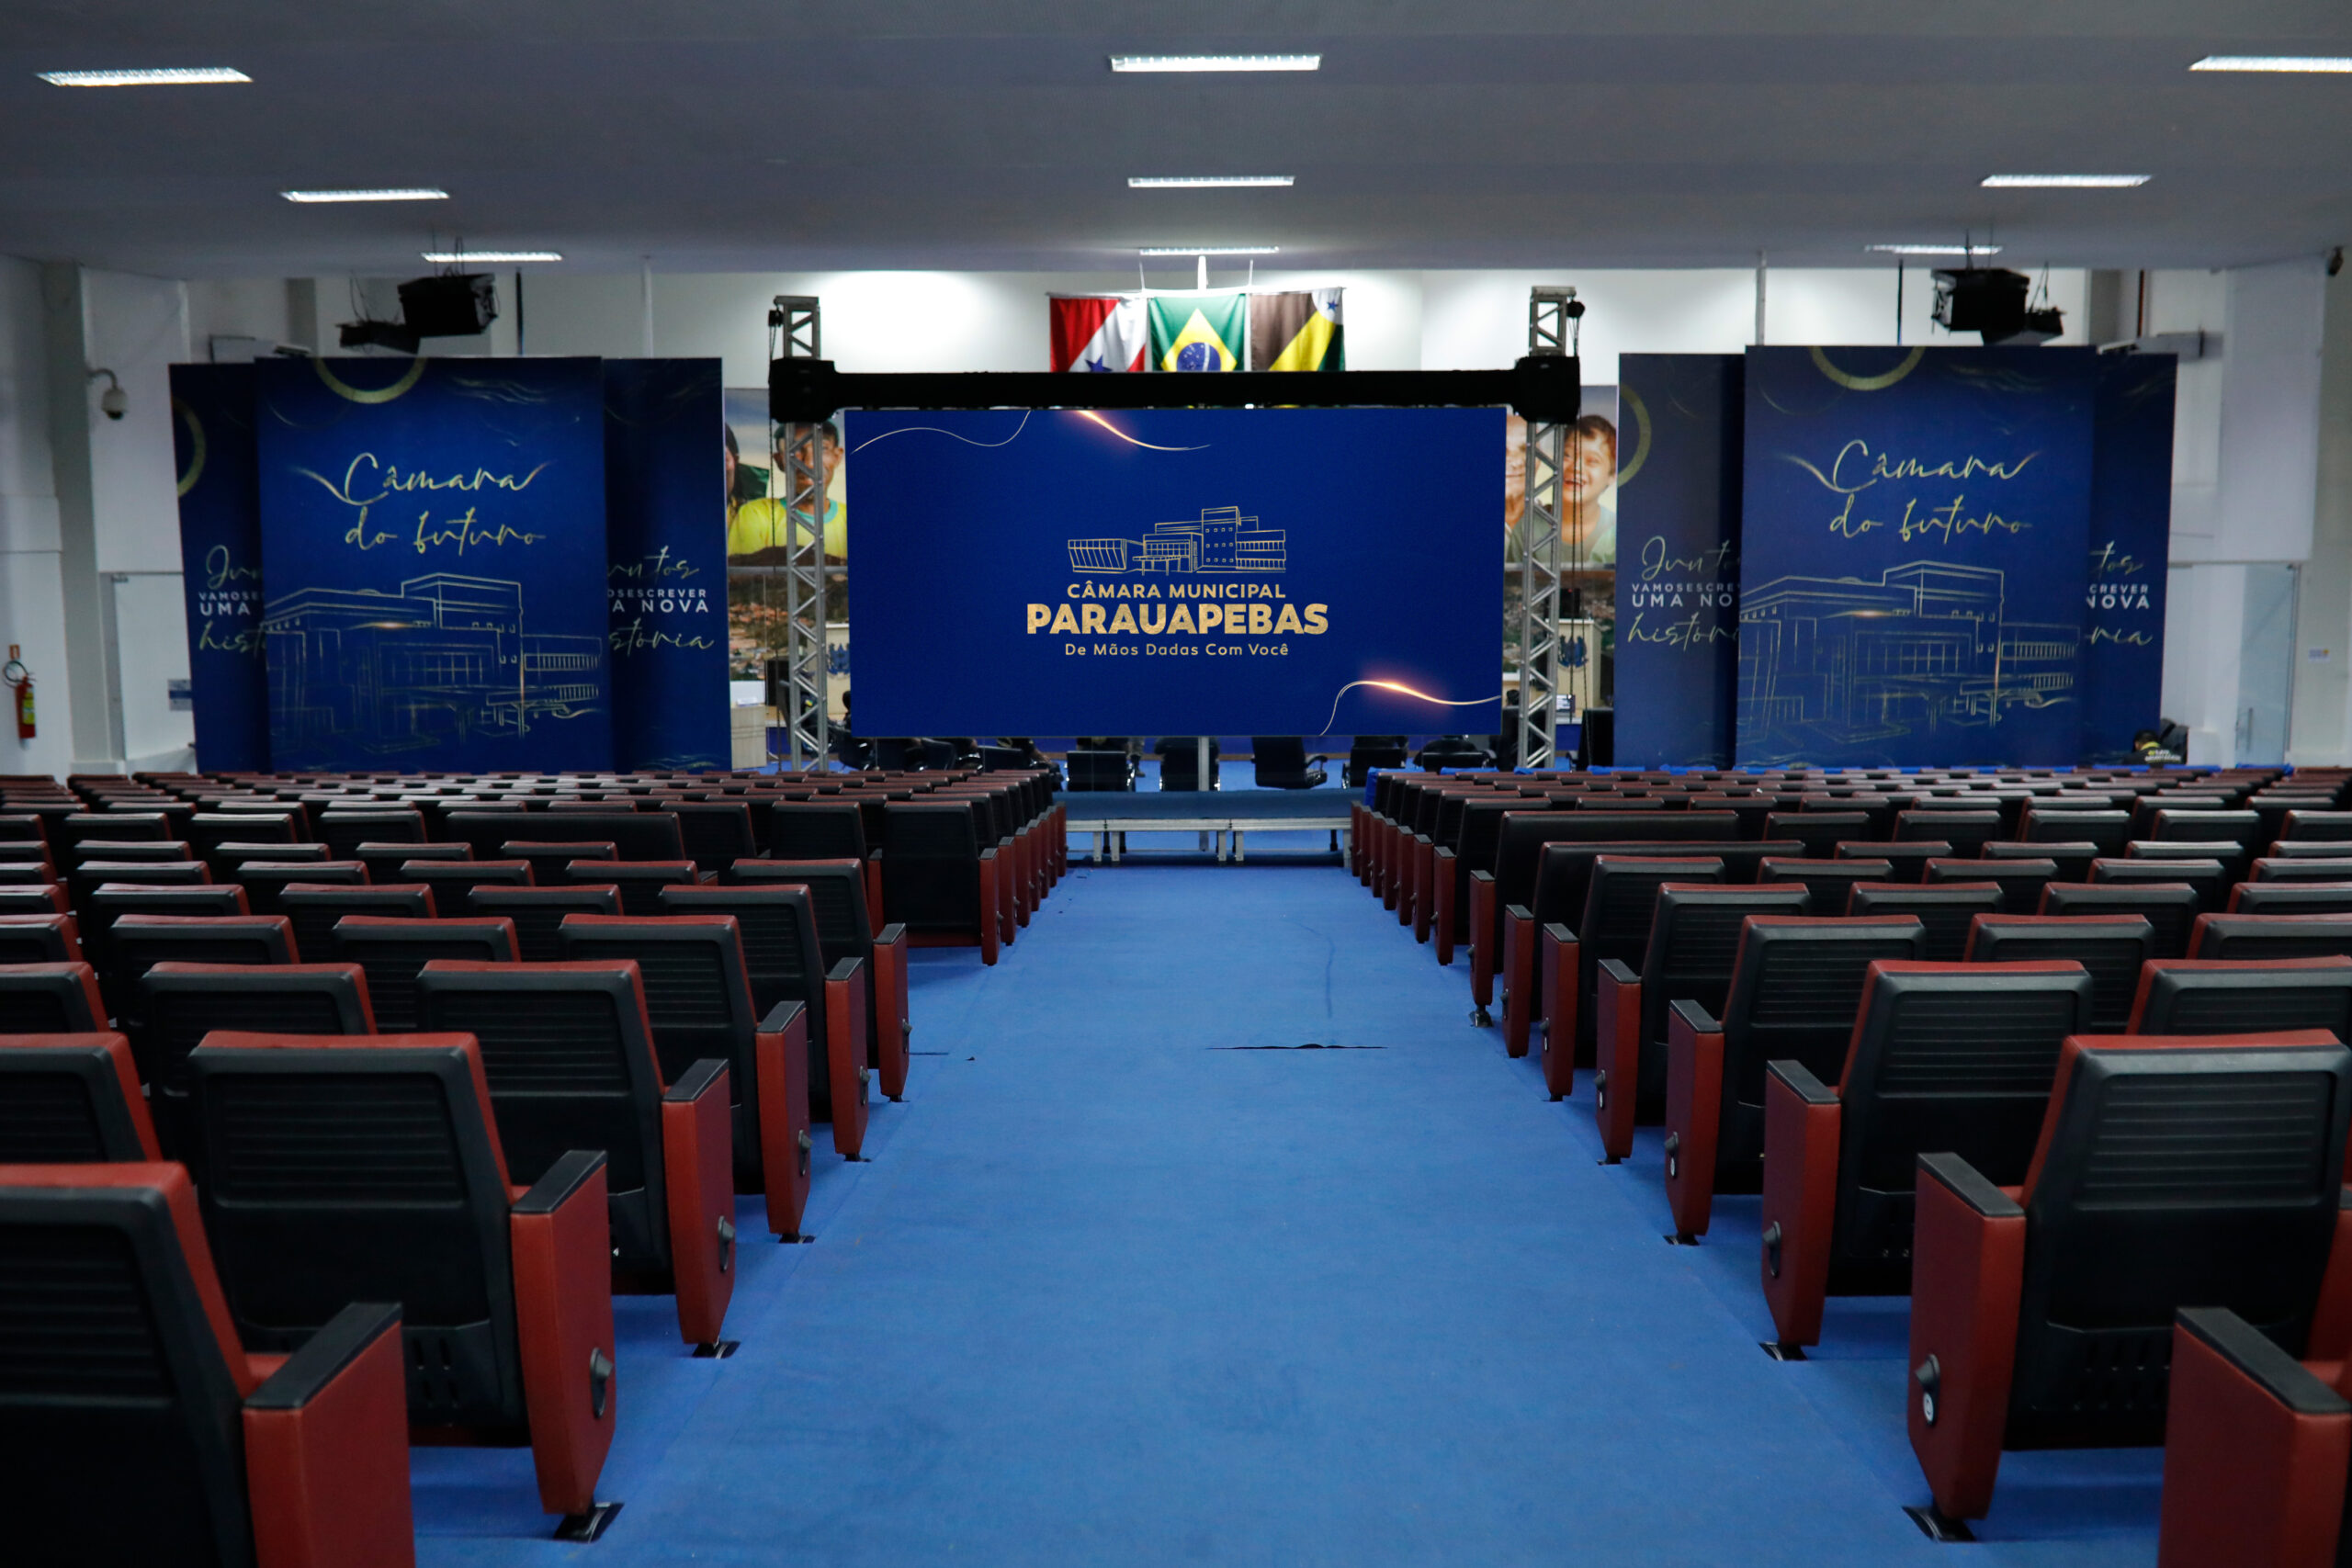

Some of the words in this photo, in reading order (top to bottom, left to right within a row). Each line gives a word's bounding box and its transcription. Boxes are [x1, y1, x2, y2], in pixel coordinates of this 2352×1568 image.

[295, 451, 550, 506] Câmara
[1780, 439, 2038, 493] Câmara
[345, 506, 398, 550] do
[413, 506, 546, 556] futuro
[1829, 493, 1883, 538] do
[1898, 494, 2032, 544] futuro
[1067, 580, 1161, 598] CÂMARA
[1170, 583, 1286, 598] MUNICIPAL
[1632, 593, 1683, 607] UMA
[1700, 593, 1733, 607] NO
[199, 602, 251, 616] UMA
[641, 599, 708, 613] NOVA
[1026, 603, 1329, 635] PARAUAPEBAS
[1065, 643, 1087, 656] De
[1093, 643, 1138, 656] Mãos
[1146, 643, 1199, 656] Dadas
[1205, 643, 1243, 656] Com
[1248, 642, 1289, 656] Você
